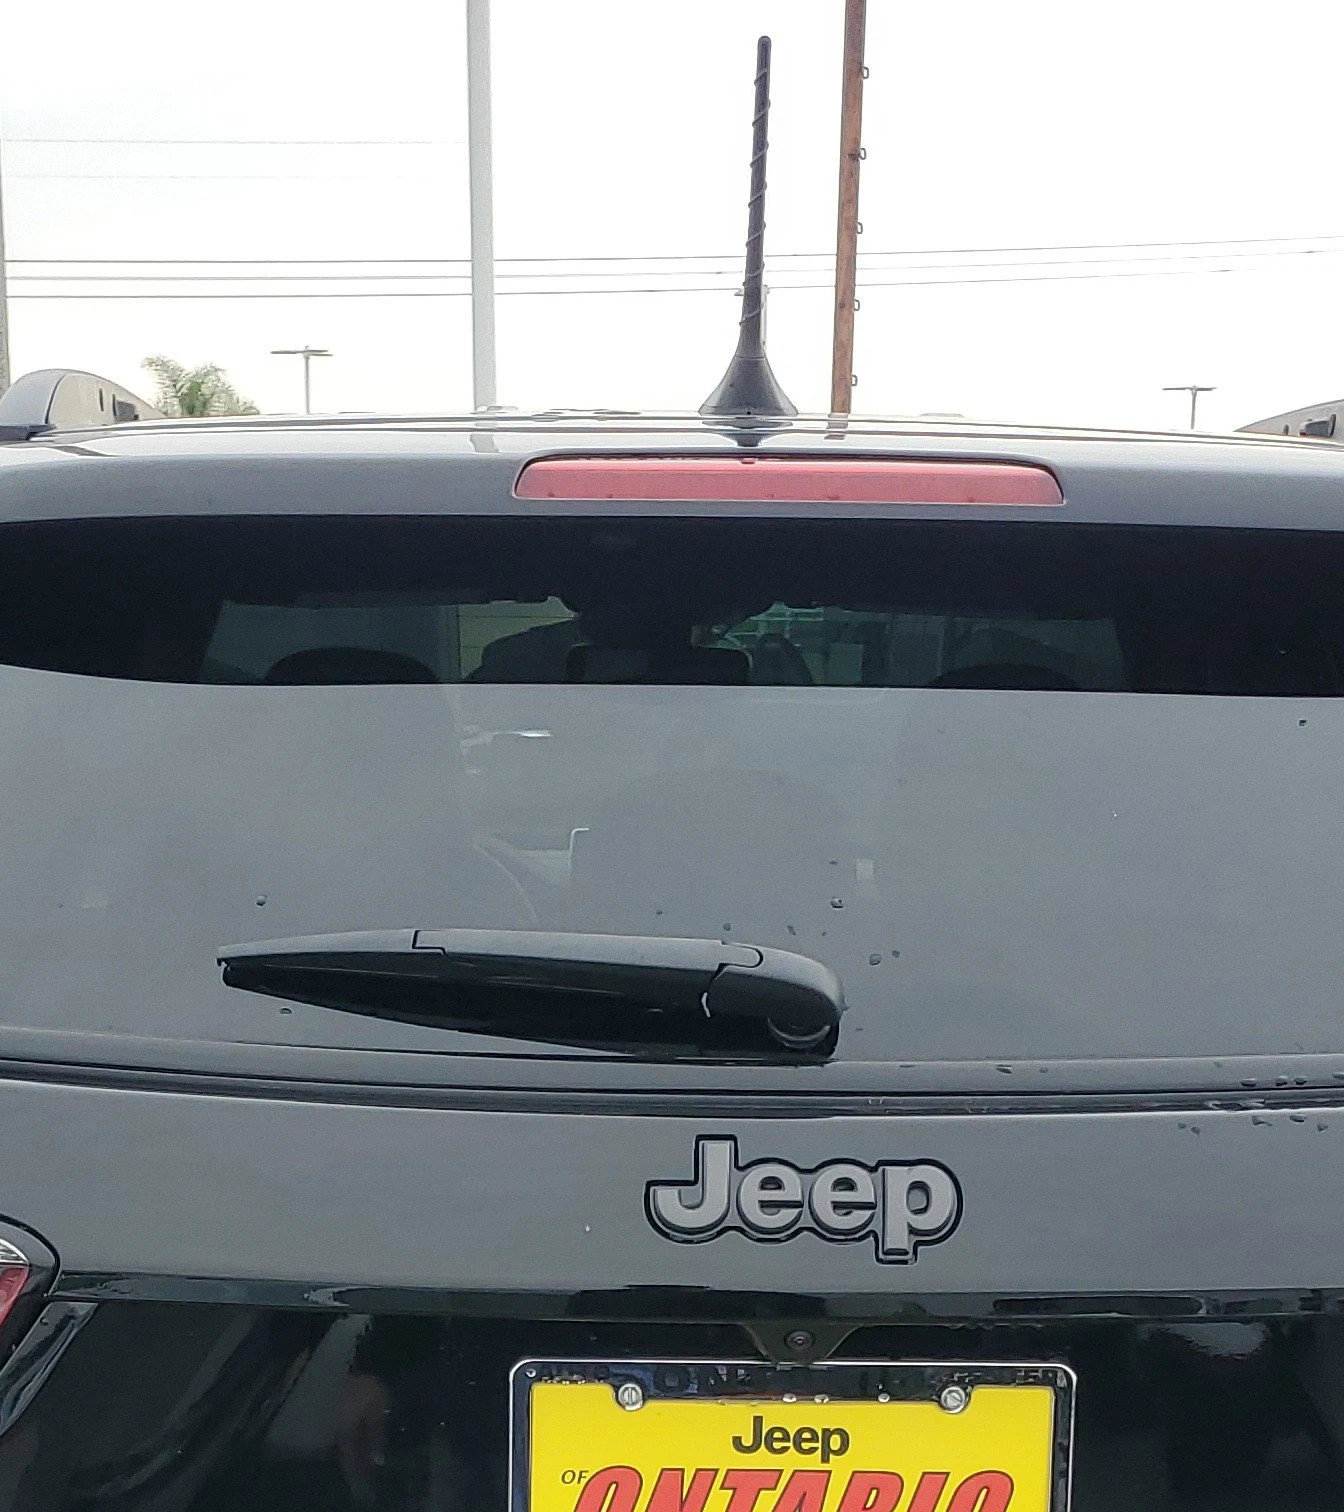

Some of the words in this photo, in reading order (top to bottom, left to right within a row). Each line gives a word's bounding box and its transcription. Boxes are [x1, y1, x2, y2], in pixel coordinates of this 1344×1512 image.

[651, 1137, 960, 1260] Jeep
[731, 1415, 851, 1463] Jeep
[560, 1469, 589, 1485] OF
